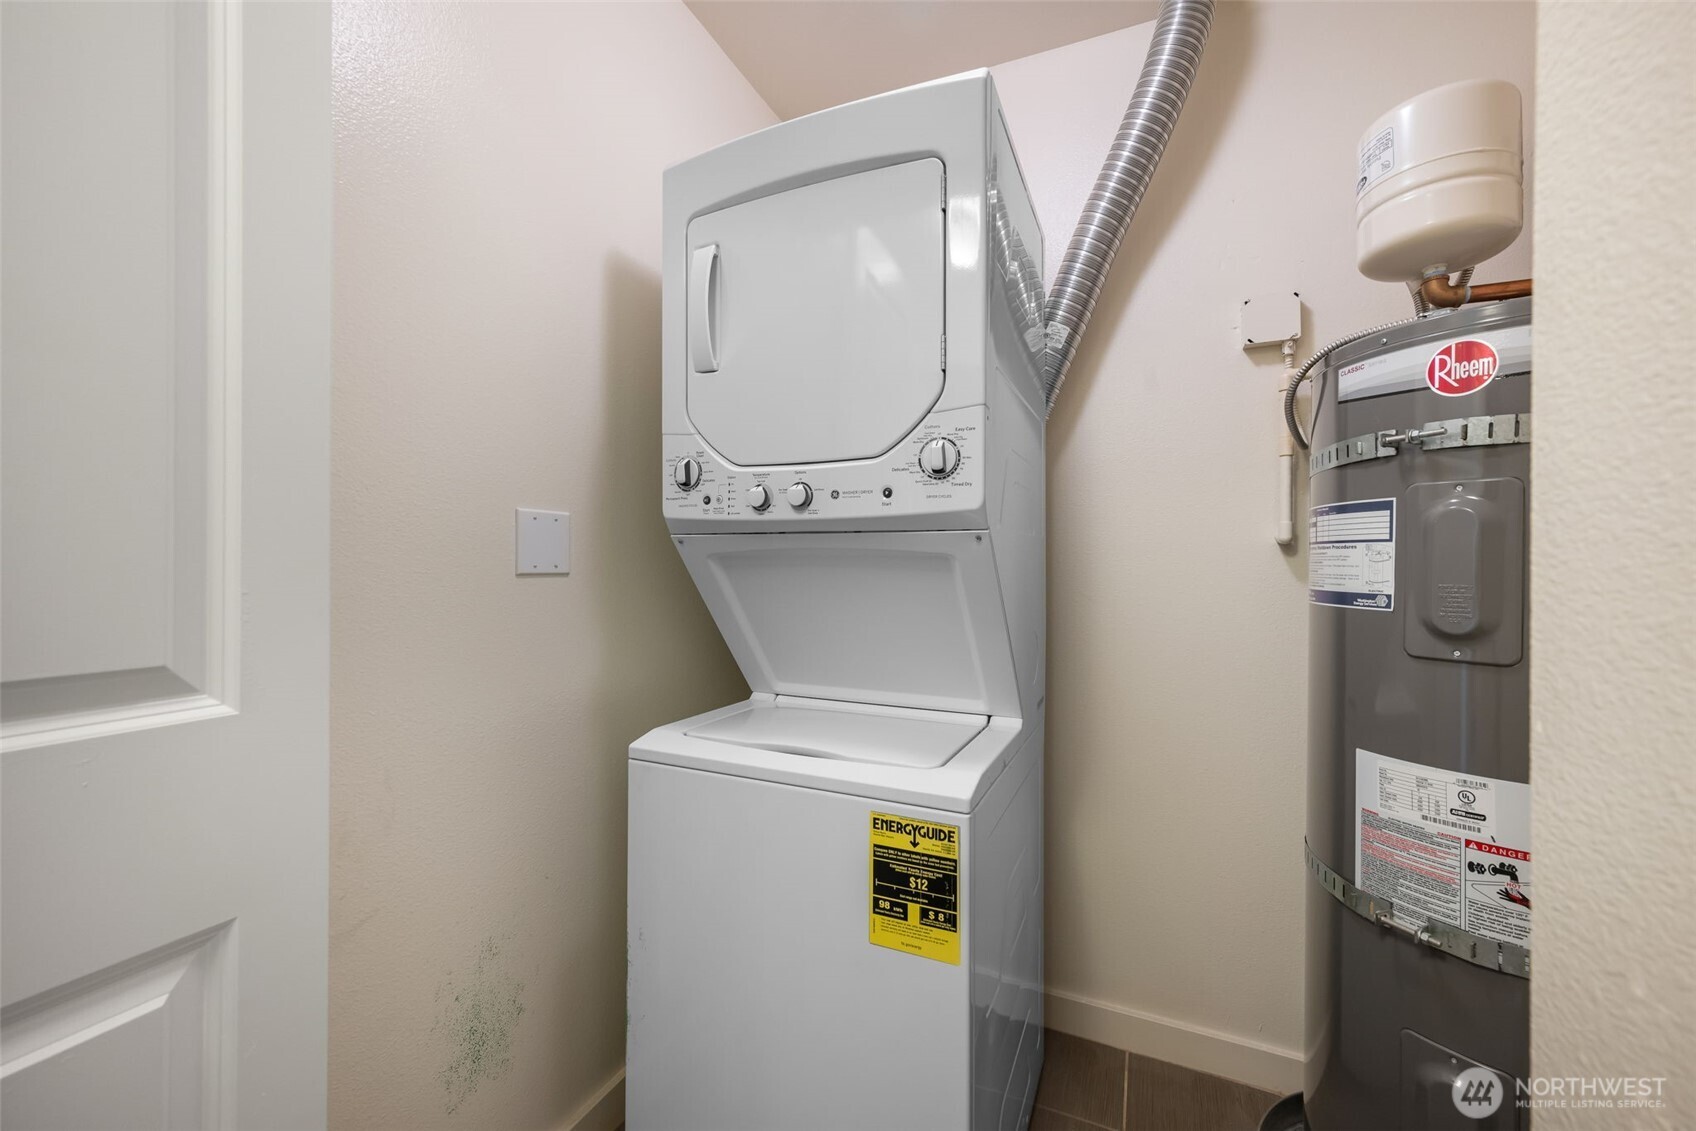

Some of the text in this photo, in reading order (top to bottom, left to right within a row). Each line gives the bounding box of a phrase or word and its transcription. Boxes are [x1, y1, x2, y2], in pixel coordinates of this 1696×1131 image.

[1340, 363, 1365, 377] CLASSIC
[1434, 343, 1494, 388] Rheem
[1462, 792, 1470, 801] UL
[873, 817, 955, 843] ENERGYGUIDE
[1437, 832, 1461, 840] CAUTION
[909, 876, 928, 891] $12
[879, 900, 890, 909] 98
[928, 911, 944, 921] $ 8
